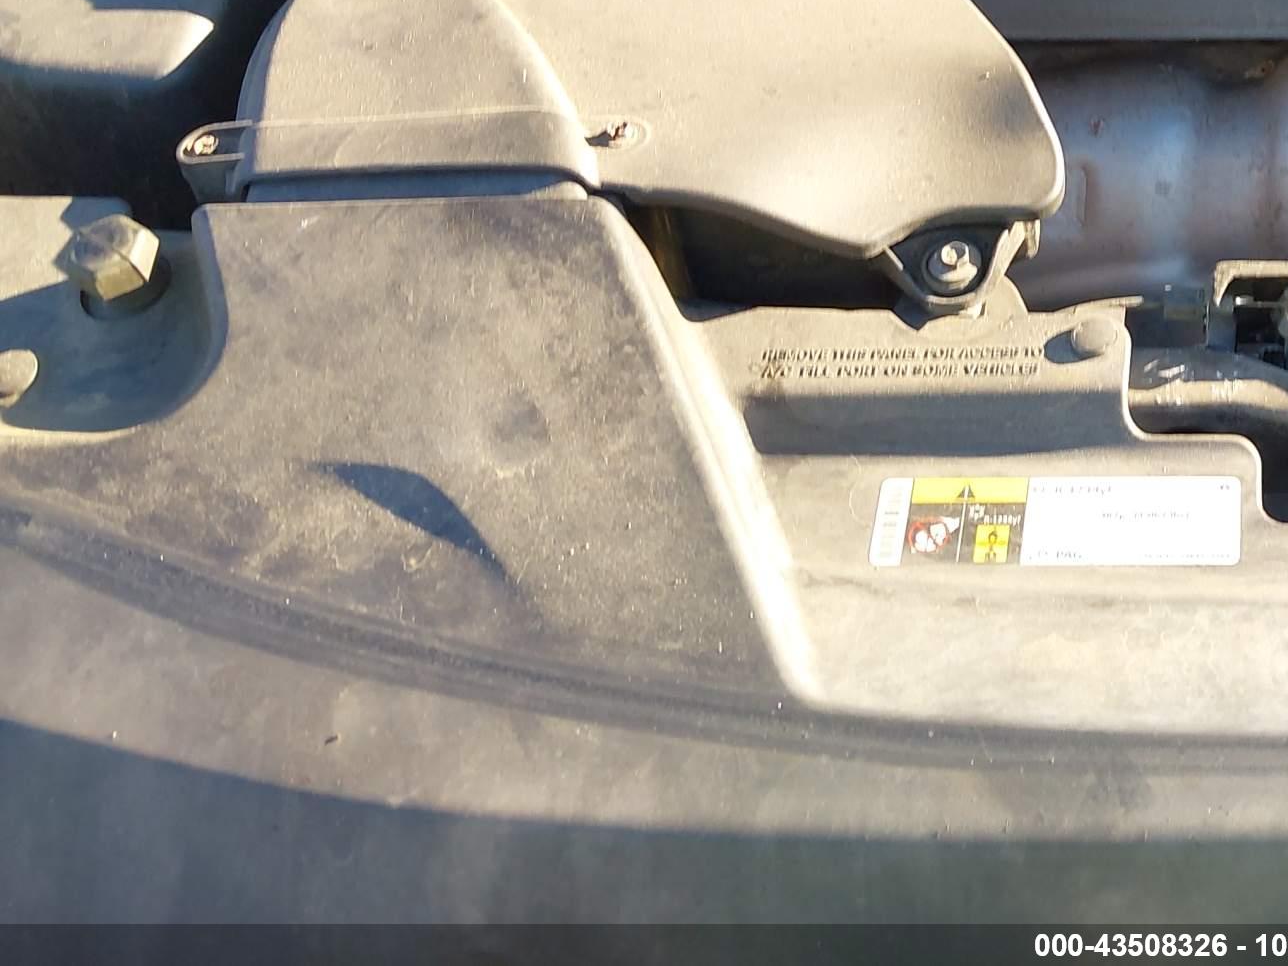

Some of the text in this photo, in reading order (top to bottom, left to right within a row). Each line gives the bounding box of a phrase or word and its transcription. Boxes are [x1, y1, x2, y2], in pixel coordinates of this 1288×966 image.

[761, 349, 827, 362] REMOVE
[870, 348, 918, 361] PANEL
[922, 348, 954, 360] FOR
[882, 365, 908, 377] ON
[963, 364, 1039, 376] VEHICLES
